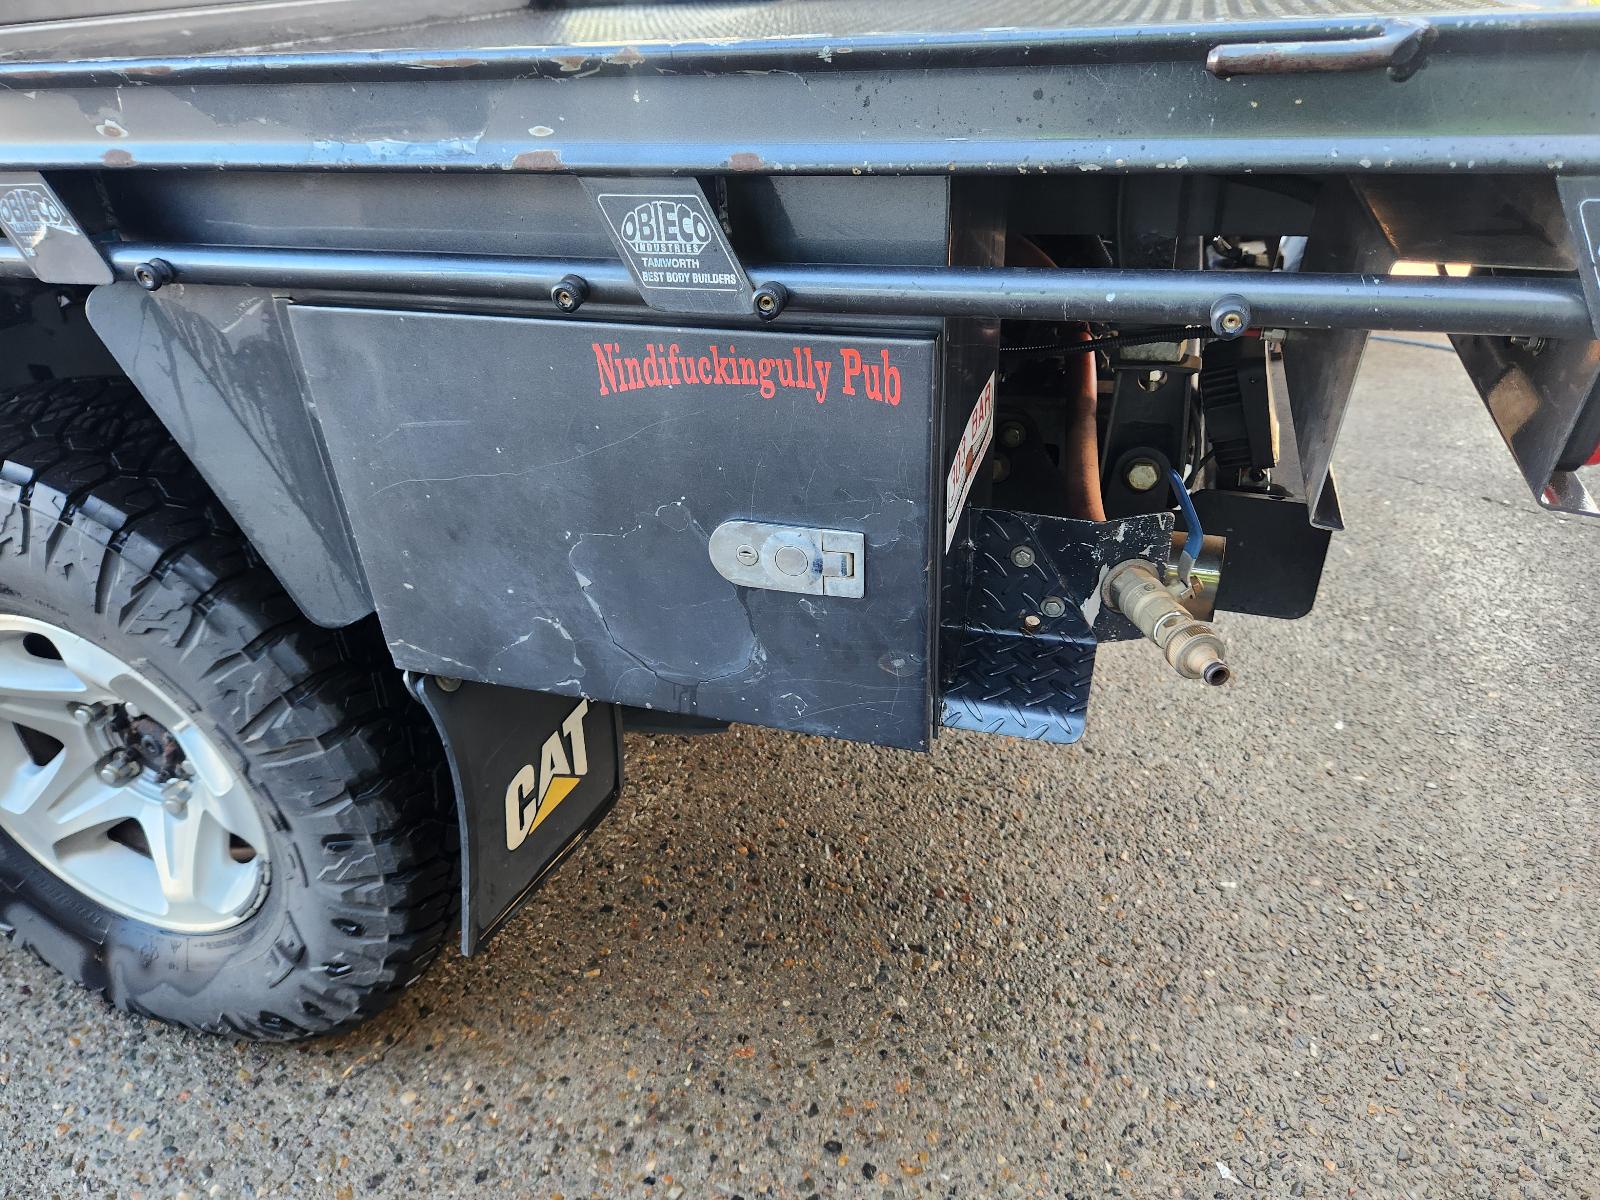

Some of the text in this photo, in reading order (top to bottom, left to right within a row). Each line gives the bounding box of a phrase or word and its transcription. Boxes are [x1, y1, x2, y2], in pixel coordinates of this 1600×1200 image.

[621, 200, 711, 243] OBIECO
[635, 243, 700, 253] INDUSTRIES
[642, 257, 700, 269] TAMWORTH
[642, 271, 737, 285] BEST BODY BUILDERS
[592, 343, 901, 406] Nindifuckingully Pub
[971, 382, 991, 439] BAR
[505, 699, 588, 851] CAT
